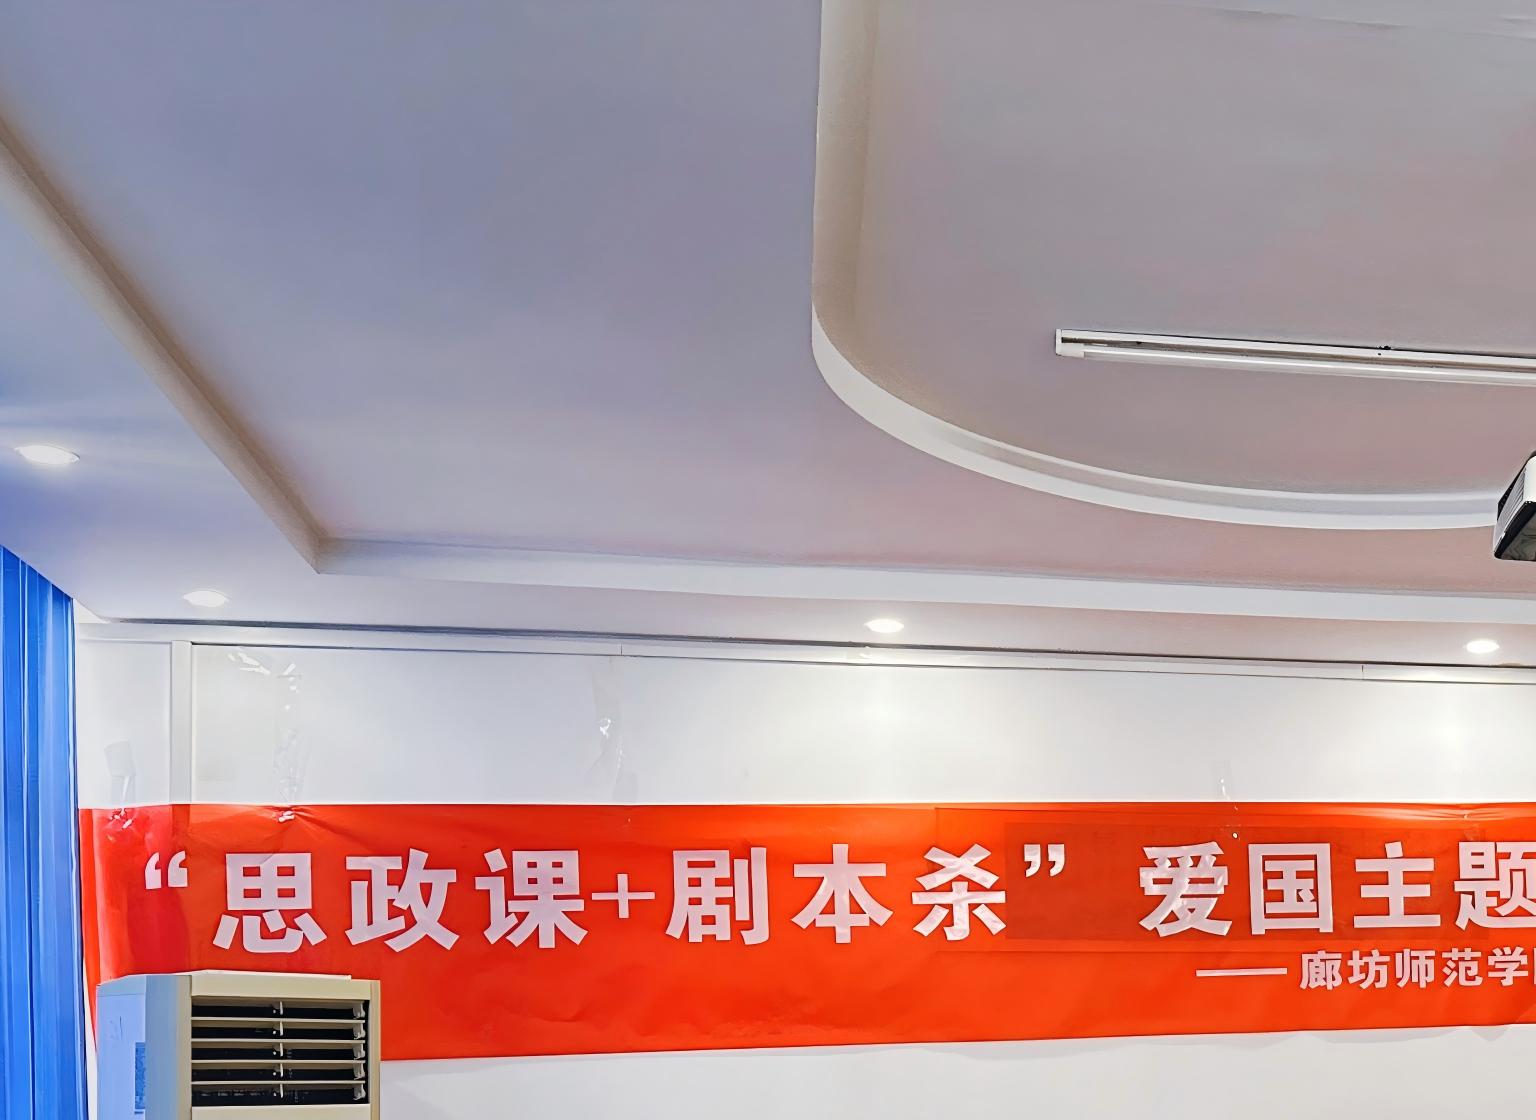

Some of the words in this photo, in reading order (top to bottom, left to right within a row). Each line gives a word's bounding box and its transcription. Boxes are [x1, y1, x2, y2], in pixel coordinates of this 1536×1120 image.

[144, 845, 1065, 953] “思政课+剧本杀”
